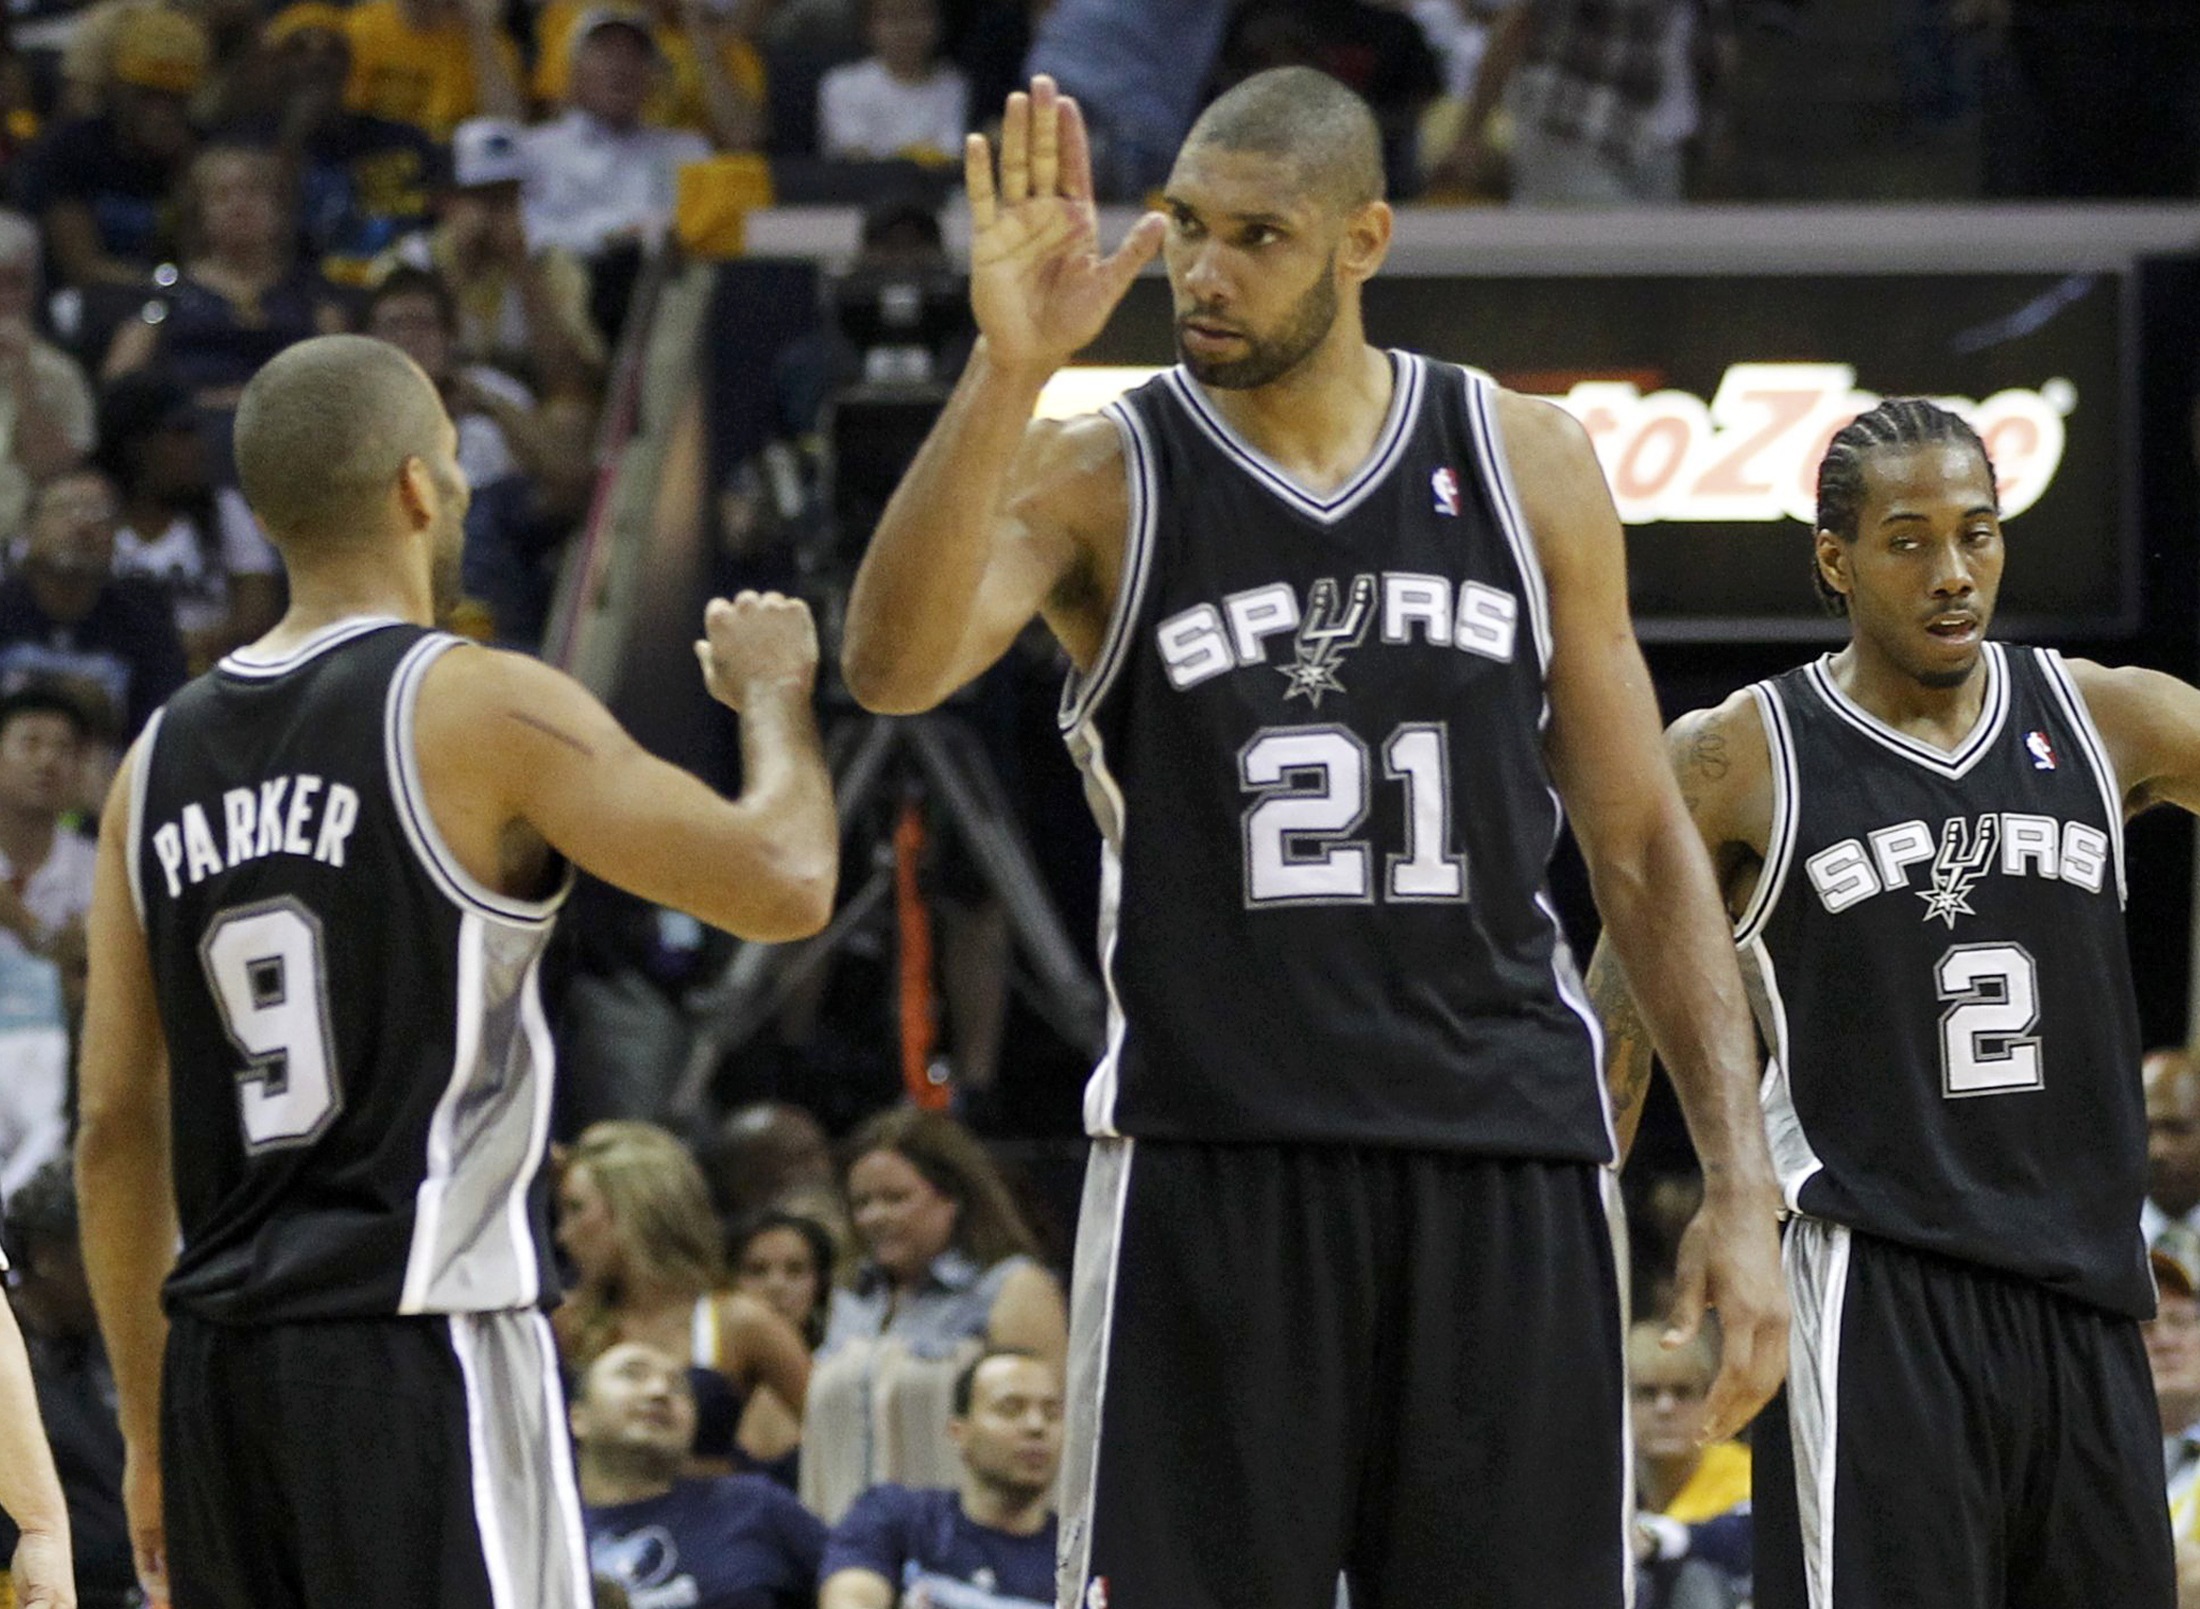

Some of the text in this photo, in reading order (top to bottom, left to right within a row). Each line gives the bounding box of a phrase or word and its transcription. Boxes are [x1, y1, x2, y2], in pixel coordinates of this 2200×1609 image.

[1156, 572, 1518, 706] SPURS
[153, 774, 359, 898] PARKER
[1237, 721, 1470, 909] 21
[1805, 812, 2109, 928] SPURS
[198, 894, 345, 1157] 9
[1933, 941, 2046, 1099] 2
